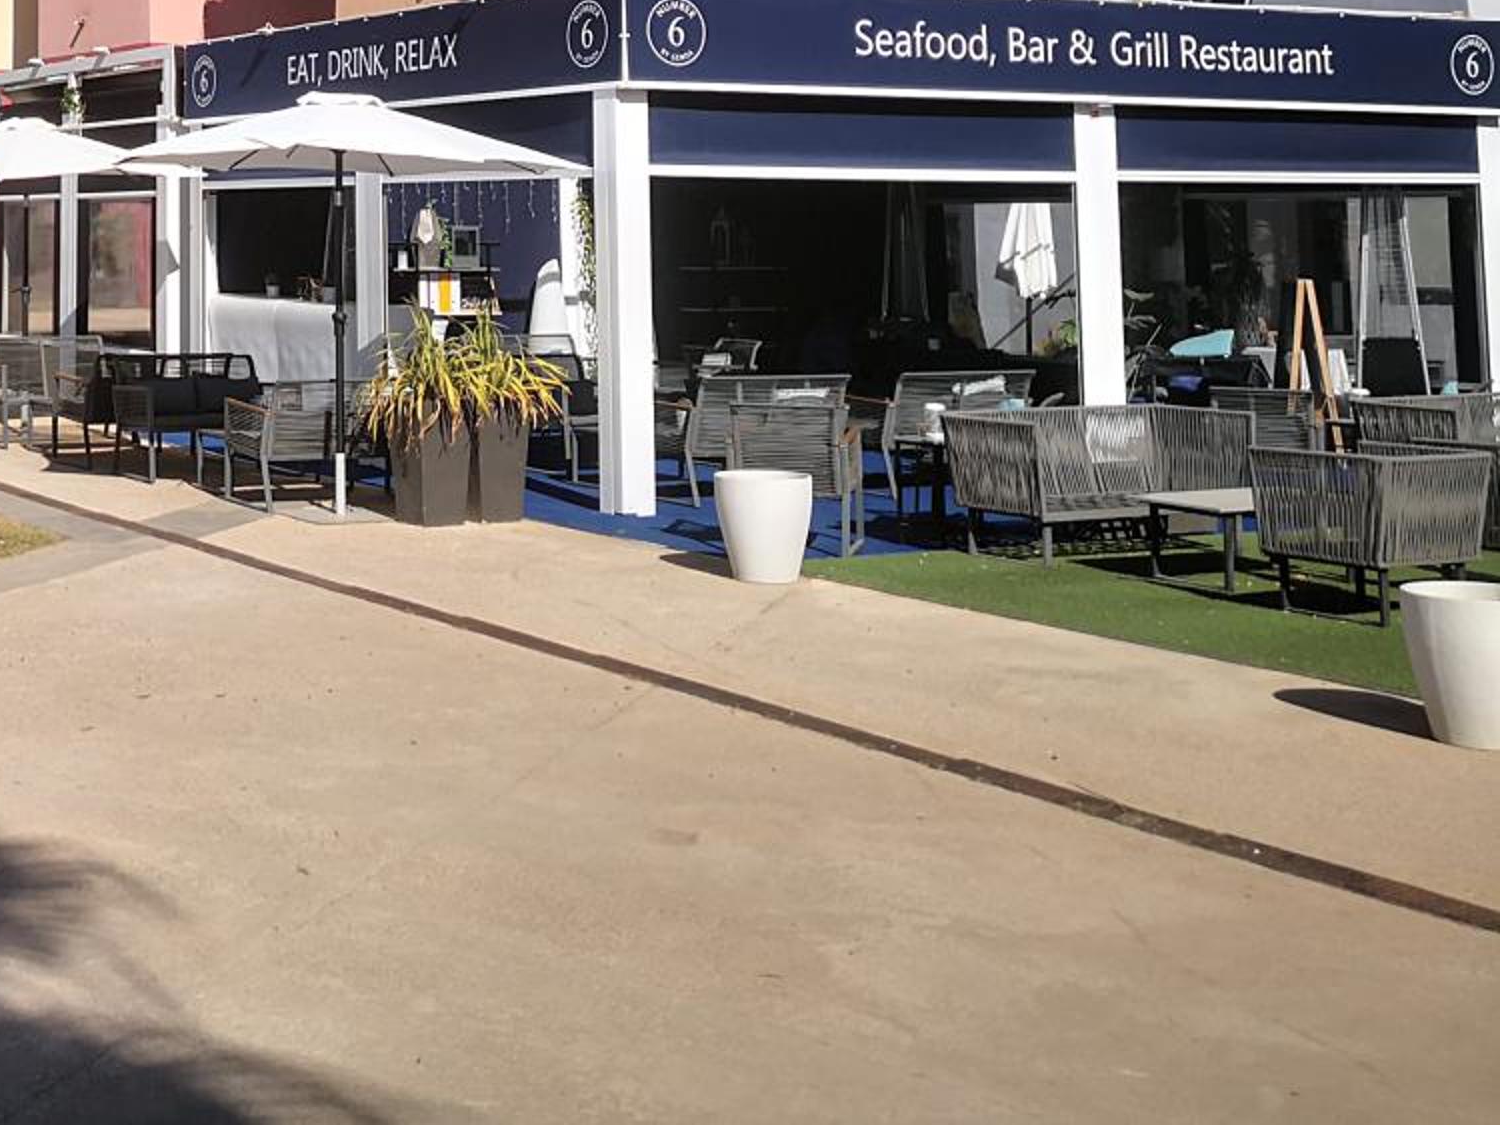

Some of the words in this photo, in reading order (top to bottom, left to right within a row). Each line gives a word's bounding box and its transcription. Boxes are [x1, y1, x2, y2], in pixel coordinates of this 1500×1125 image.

[573, 5, 600, 23] NUMBER
[655, 1, 697, 19] NUMBER
[581, 18, 593, 49] 6
[668, 16, 685, 47] 6
[287, 52, 322, 87] EAT,
[327, 43, 389, 80] DRINK,
[395, 33, 458, 74] RELAX
[854, 18, 997, 67] Seafood,
[1007, 26, 1059, 63] Bar
[1069, 29, 1097, 65] &
[1110, 31, 1169, 68] Grill
[1179, 34, 1335, 75] Restaurant
[1466, 51, 1479, 78] 6
[200, 69, 209, 93] 6
